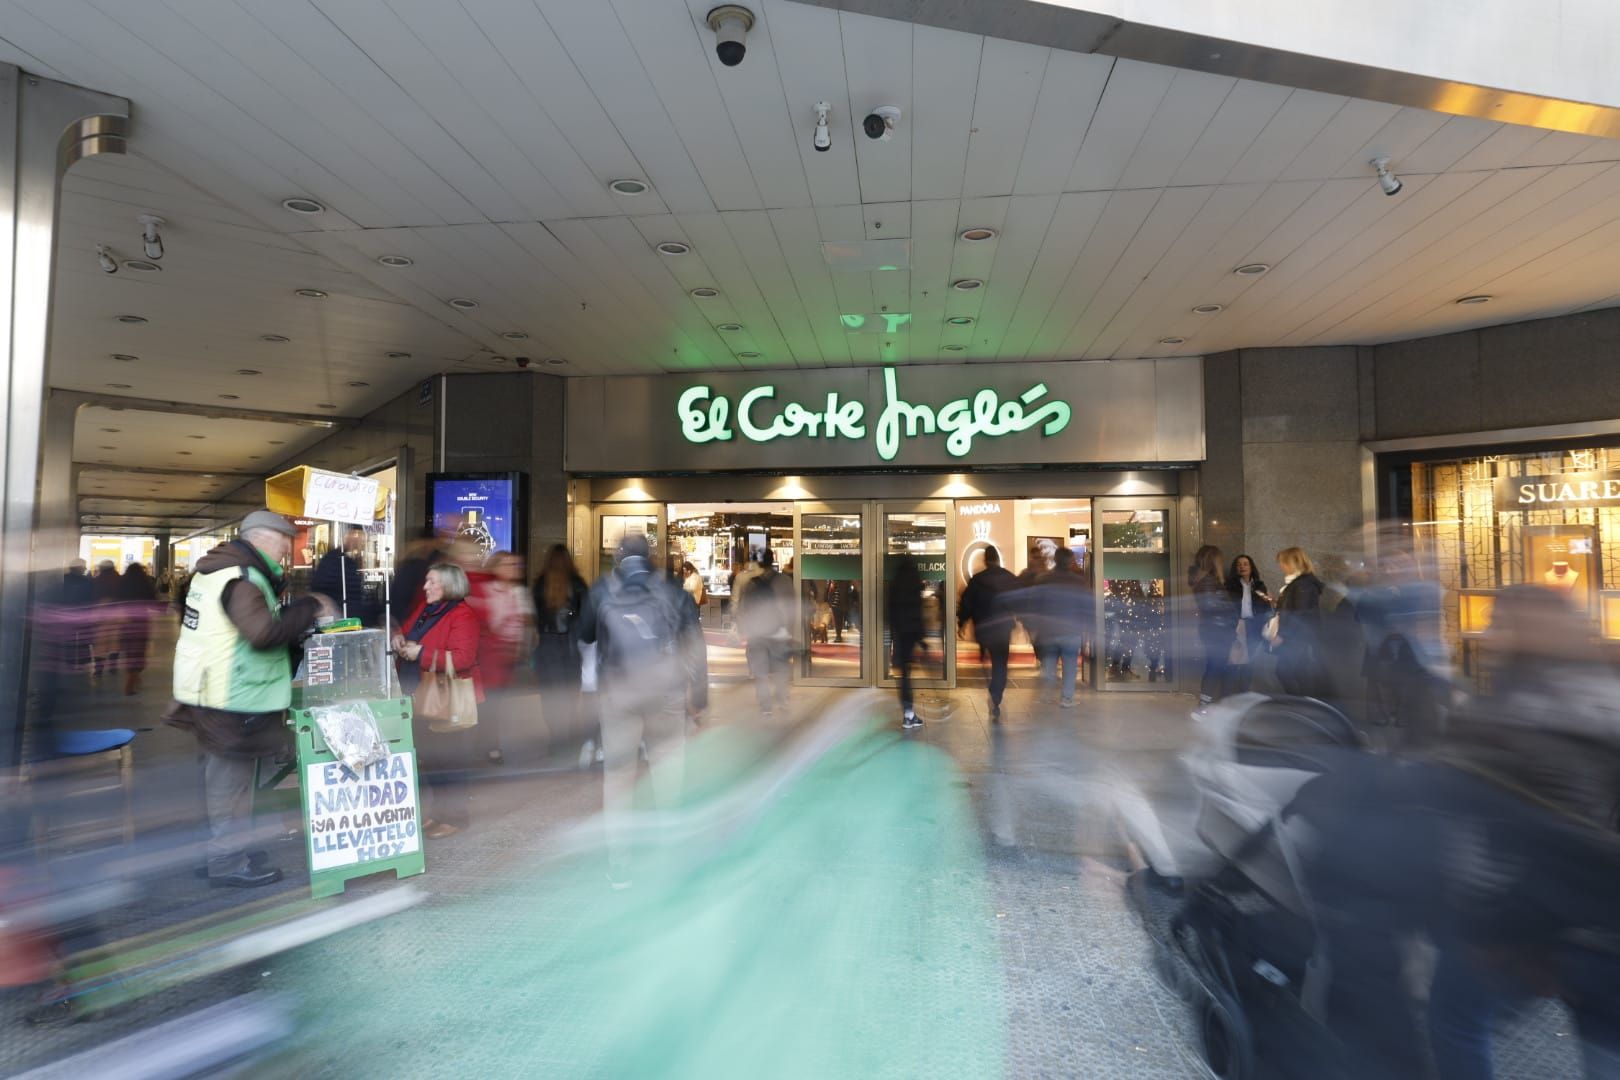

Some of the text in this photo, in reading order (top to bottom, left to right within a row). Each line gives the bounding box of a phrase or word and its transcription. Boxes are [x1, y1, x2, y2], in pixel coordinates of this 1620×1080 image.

[677, 366, 1071, 461] El Corte Inglés
[1518, 480, 1620, 504] SUARE
[959, 502, 1002, 516] PANDORA
[917, 562, 946, 571] BLACK
[323, 756, 408, 786] EXTRA
[314, 780, 408, 816] NAVIDAD
[339, 816, 350, 829] A
[353, 815, 372, 829] LA
[374, 806, 415, 825] VENTA!
[312, 821, 417, 854] LLEVATELO
[356, 841, 406, 863] HOY
